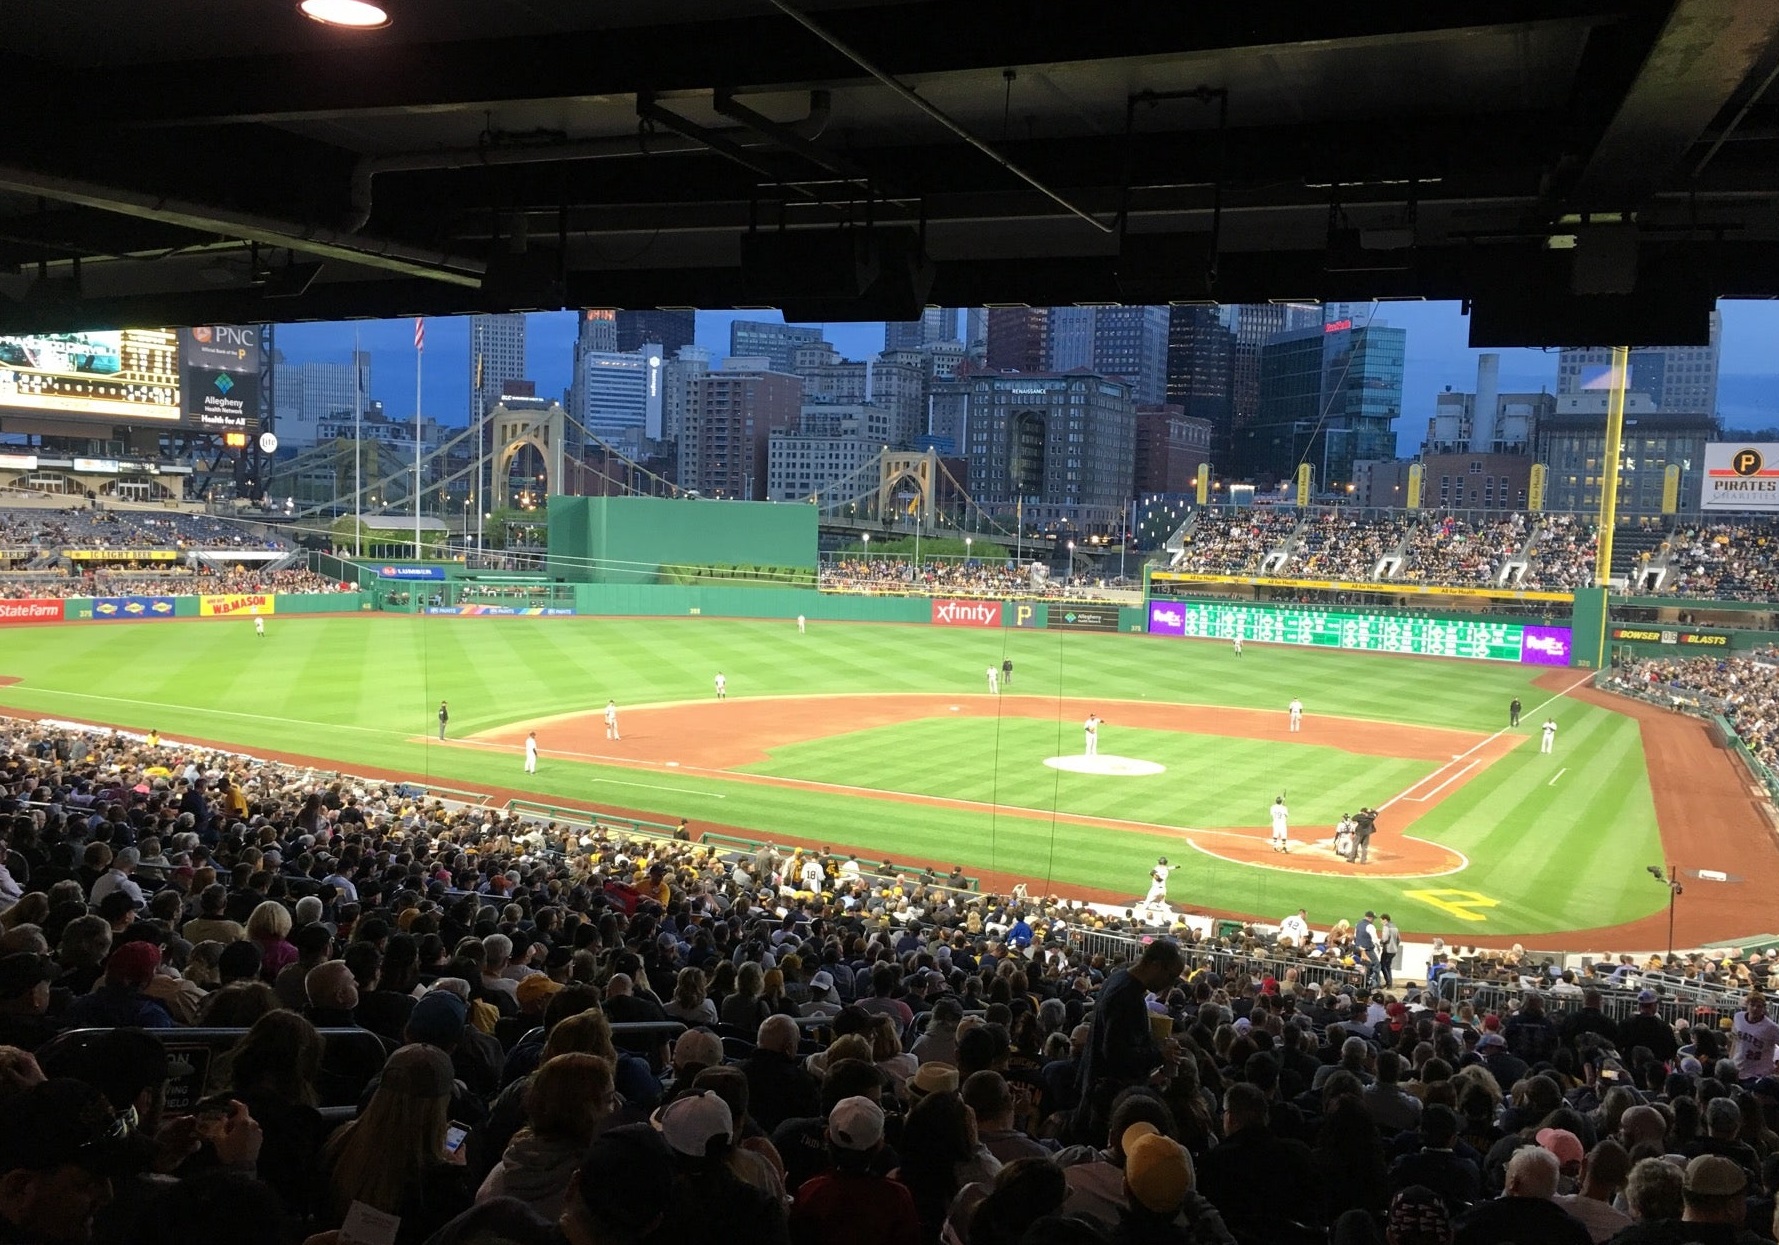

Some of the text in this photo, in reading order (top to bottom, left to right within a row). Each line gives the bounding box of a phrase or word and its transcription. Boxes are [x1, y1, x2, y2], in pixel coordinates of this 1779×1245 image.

[215, 326, 254, 347] PNC
[205, 396, 243, 408] Allegheny
[201, 415, 224, 424] Health
[236, 418, 246, 426] All
[262, 438, 276, 448] Lite
[1740, 454, 1755, 472] P
[1714, 480, 1776, 491] PIRATES
[1713, 492, 1779, 500] CHARITIES
[102, 552, 129, 560] LIGHT
[132, 552, 152, 560] BEER
[213, 596, 266, 614] W.B.MASON
[1279, 604, 1332, 612] WELCOME
[936, 602, 996, 624] xfinity
[1016, 606, 1032, 626] P
[1153, 610, 1182, 624] FedEx
[1620, 630, 1660, 640] BOWSER
[1688, 635, 1726, 645] BLASTS
[1526, 635, 1564, 651] FedEx
[806, 870, 816, 880] 18
[1288, 920, 1300, 930] 42
